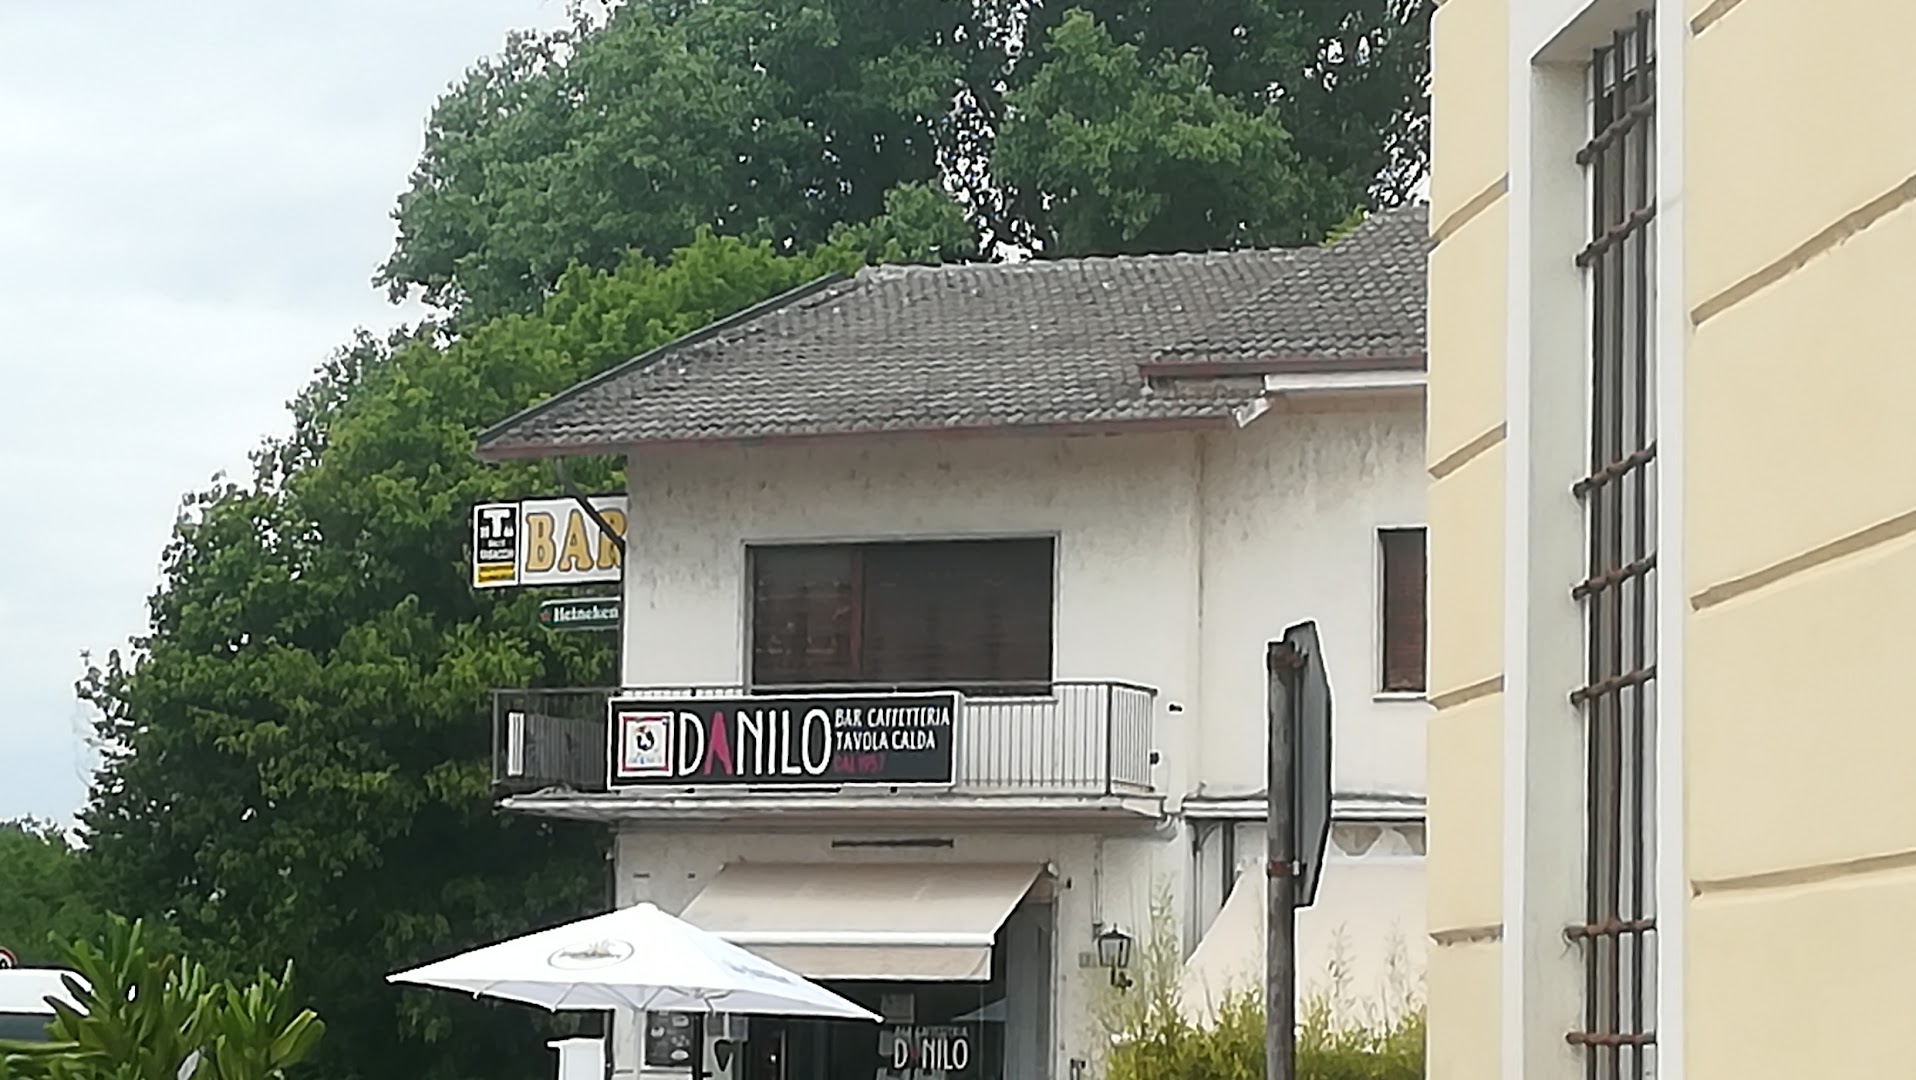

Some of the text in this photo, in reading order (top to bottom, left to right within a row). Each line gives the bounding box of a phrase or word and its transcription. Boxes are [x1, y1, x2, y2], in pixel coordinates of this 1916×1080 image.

[483, 508, 511, 538] T
[525, 508, 627, 573] BAR
[553, 606, 620, 623] Heineken
[834, 706, 950, 728] BAR CAFFETTERIA
[678, 709, 832, 776] DANILO
[836, 729, 936, 751] TAVOLA CALDA
